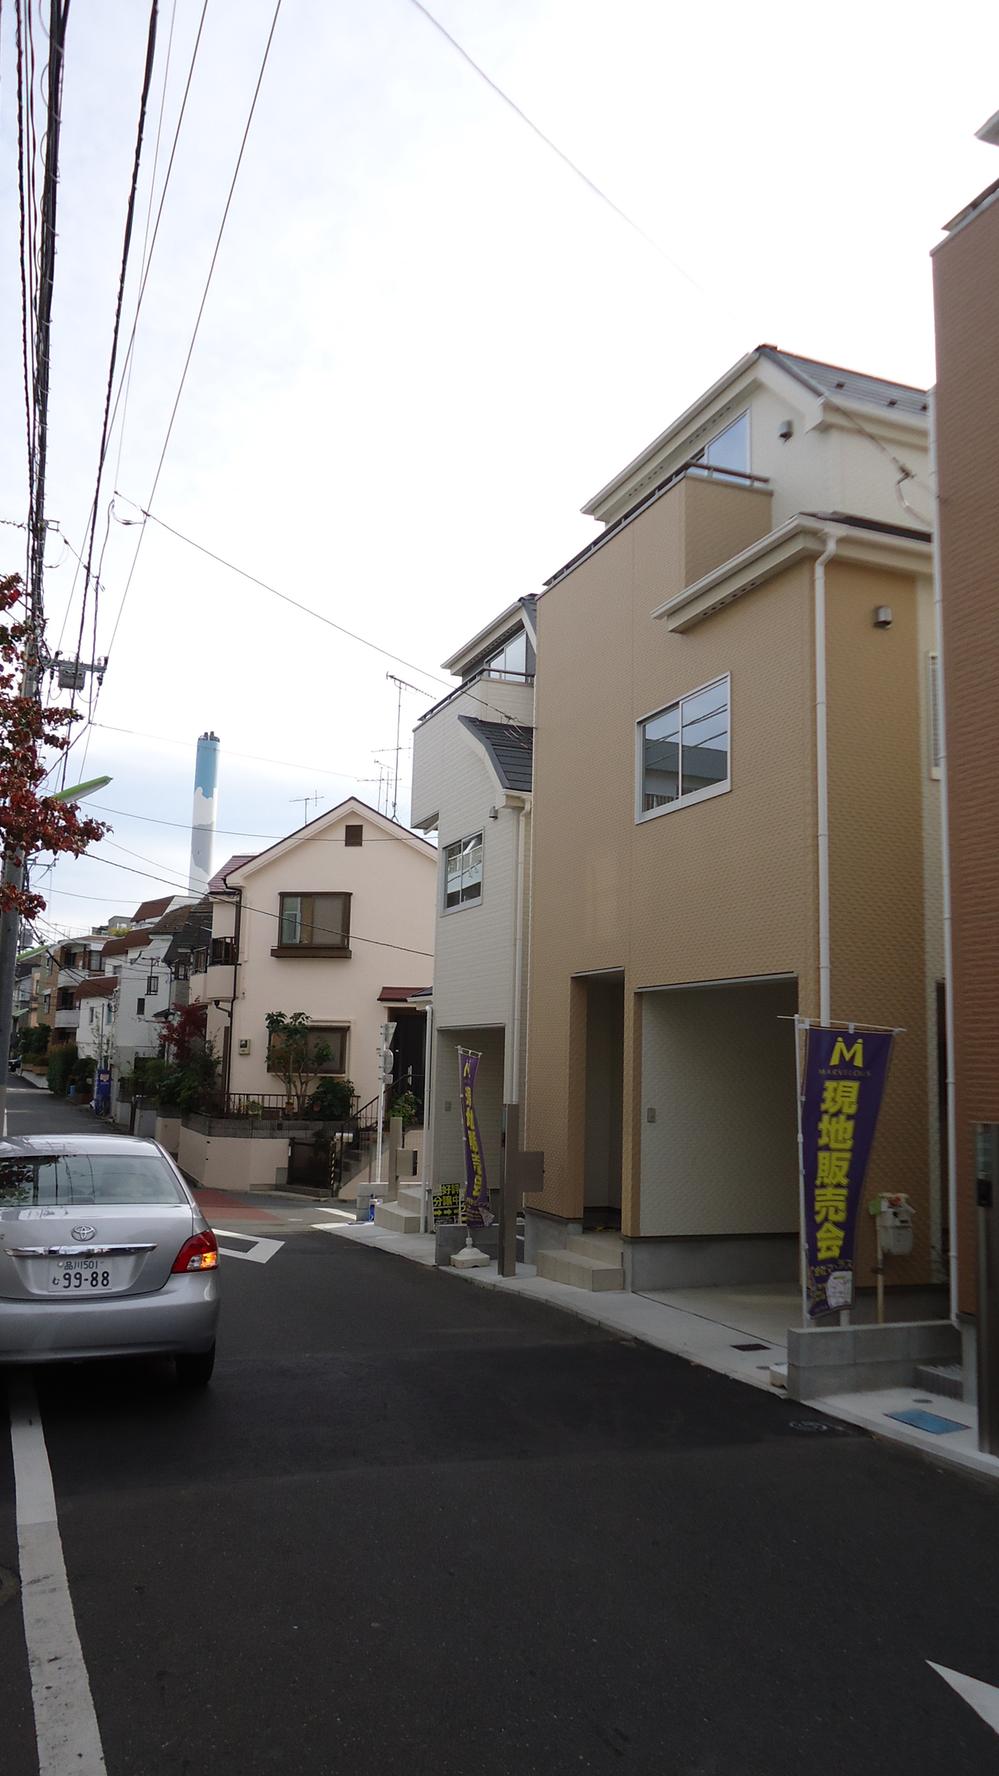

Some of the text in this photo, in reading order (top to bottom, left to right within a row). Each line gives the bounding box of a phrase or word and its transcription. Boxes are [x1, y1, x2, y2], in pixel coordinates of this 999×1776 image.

[814, 1080, 860, 1260] 現地販売会
[63, 1271, 109, 1289] 99-88
